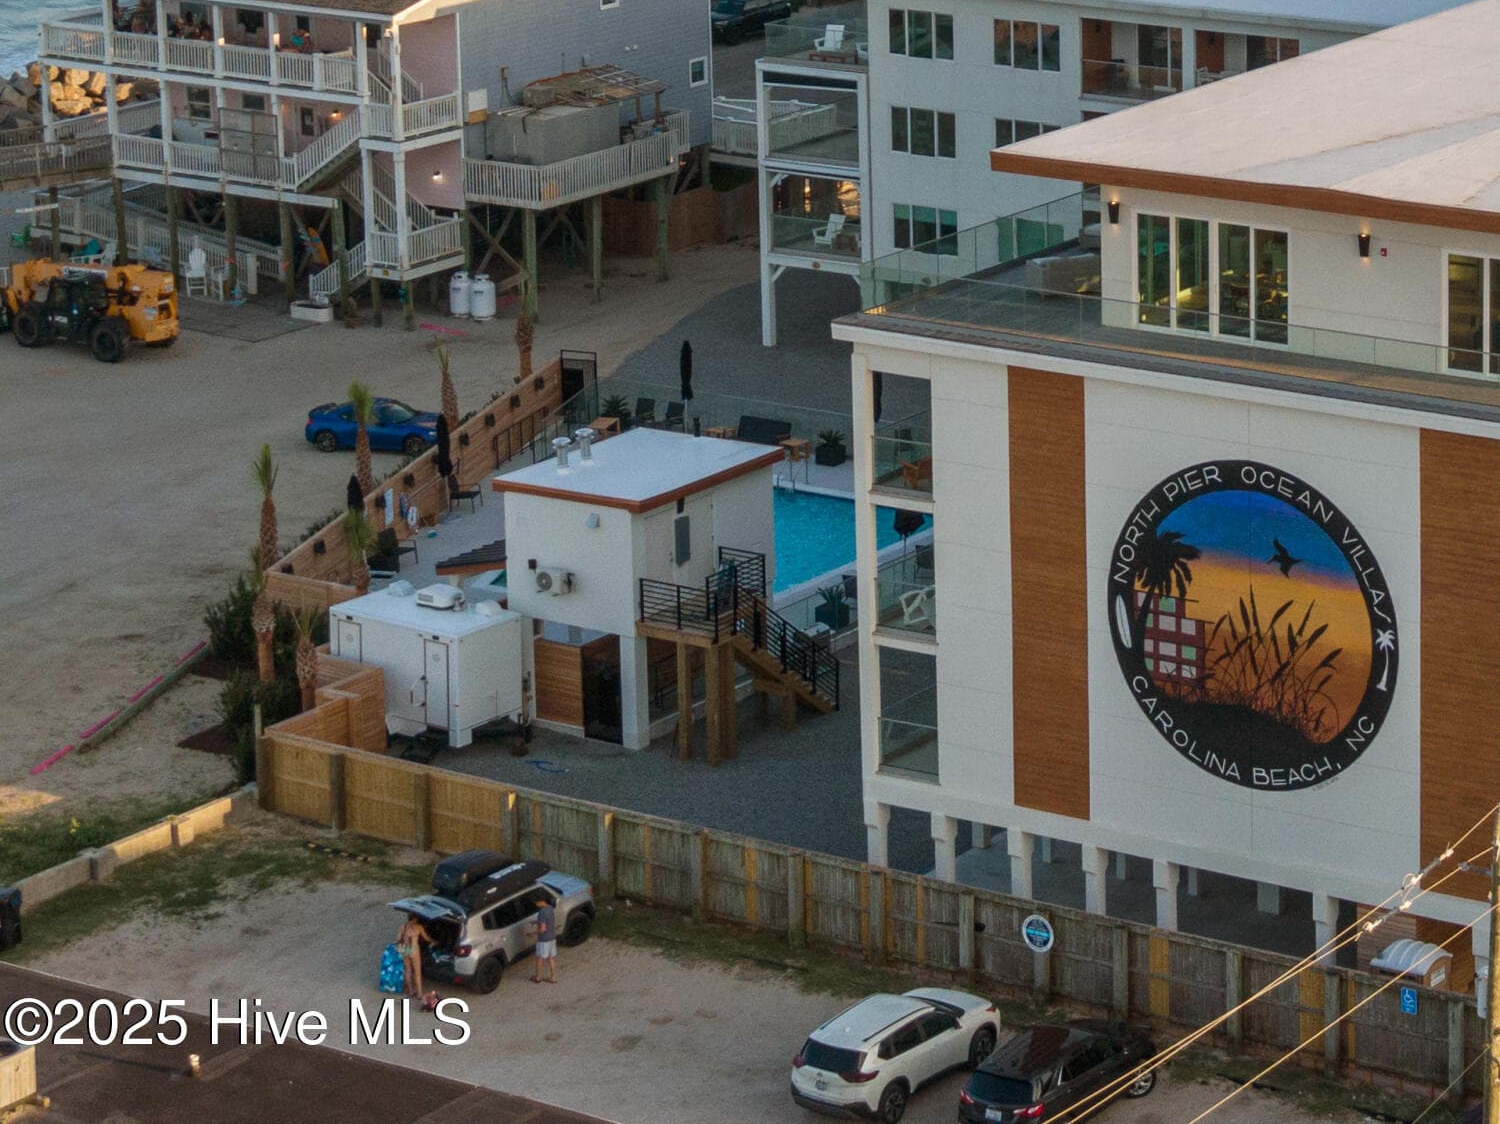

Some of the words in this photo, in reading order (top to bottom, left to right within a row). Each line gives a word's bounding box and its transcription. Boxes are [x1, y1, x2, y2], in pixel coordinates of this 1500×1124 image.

[1114, 503, 1160, 584] NORTH
[1163, 466, 1223, 503] PIER
[1241, 466, 1335, 523] OCEAN
[1132, 675, 1241, 780] CAROLINA
[1252, 757, 1342, 786] BEACH,
[1345, 716, 1376, 753] NC
